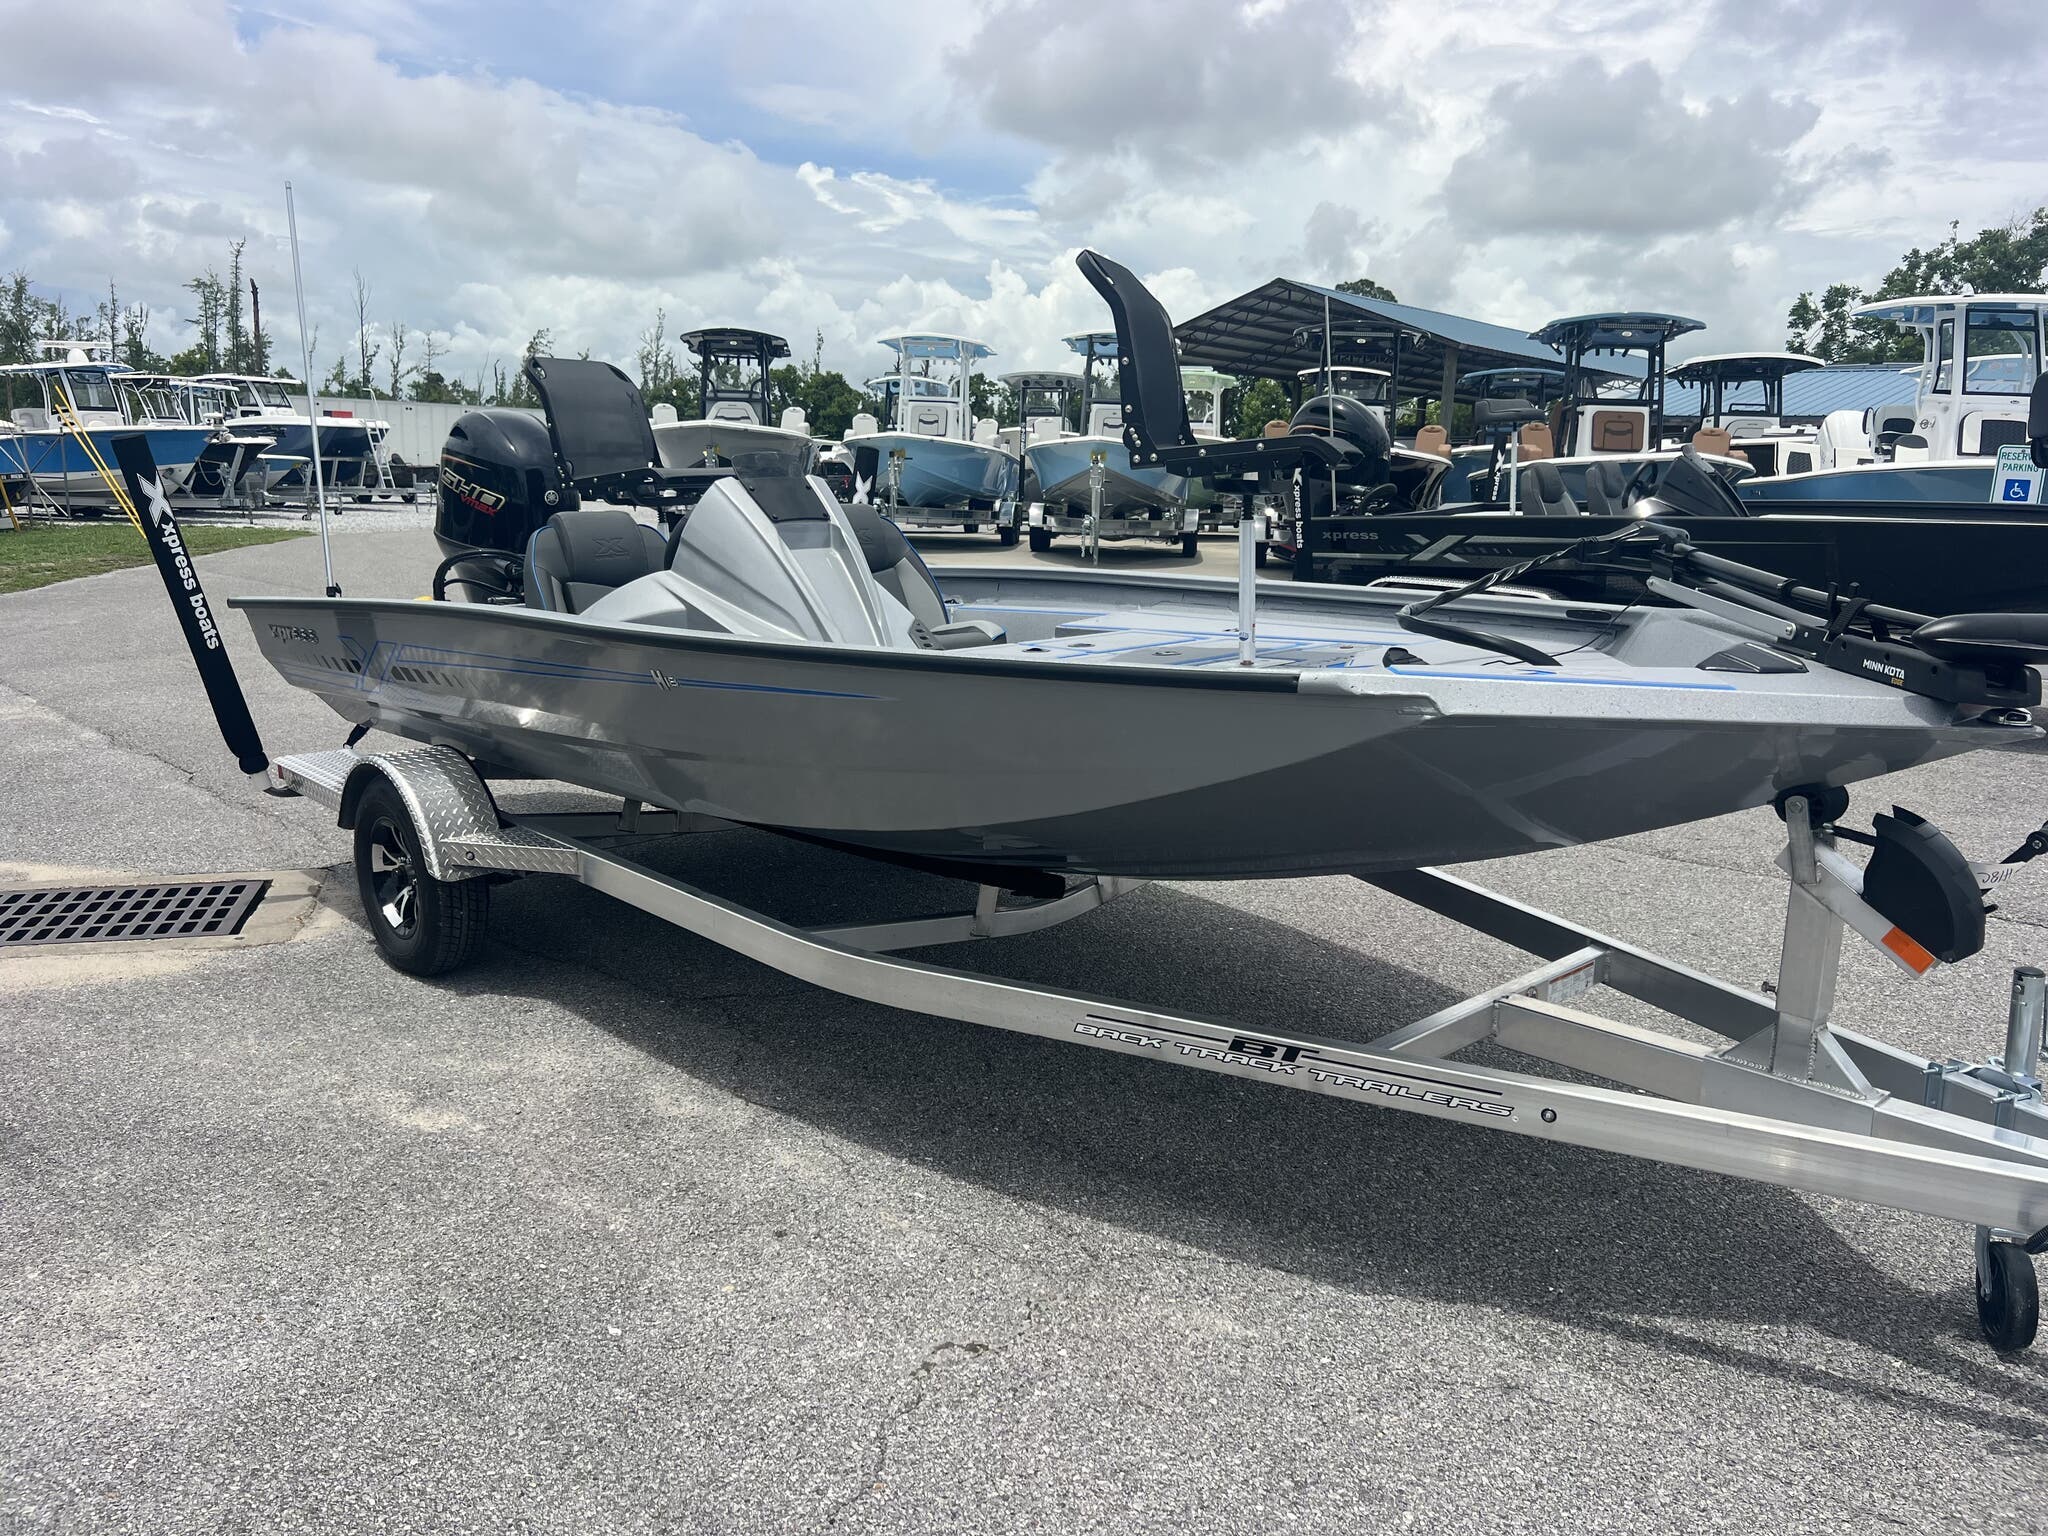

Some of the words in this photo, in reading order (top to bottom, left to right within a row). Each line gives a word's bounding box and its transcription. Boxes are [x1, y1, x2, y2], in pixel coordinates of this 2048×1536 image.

[2001, 452, 2032, 461] RESERV
[1293, 484, 1303, 519] xpress
[1295, 521, 1304, 549] boats
[1322, 531, 1379, 541] xpress
[161, 521, 197, 591] xpress
[189, 592, 219, 650] boats
[1862, 658, 1885, 673] MINN
[1883, 664, 1905, 680] KOTA
[1074, 1022, 1170, 1049] BACK
[1174, 1041, 1304, 1075] TRACK
[1308, 1068, 1515, 1117] TRAILERS
